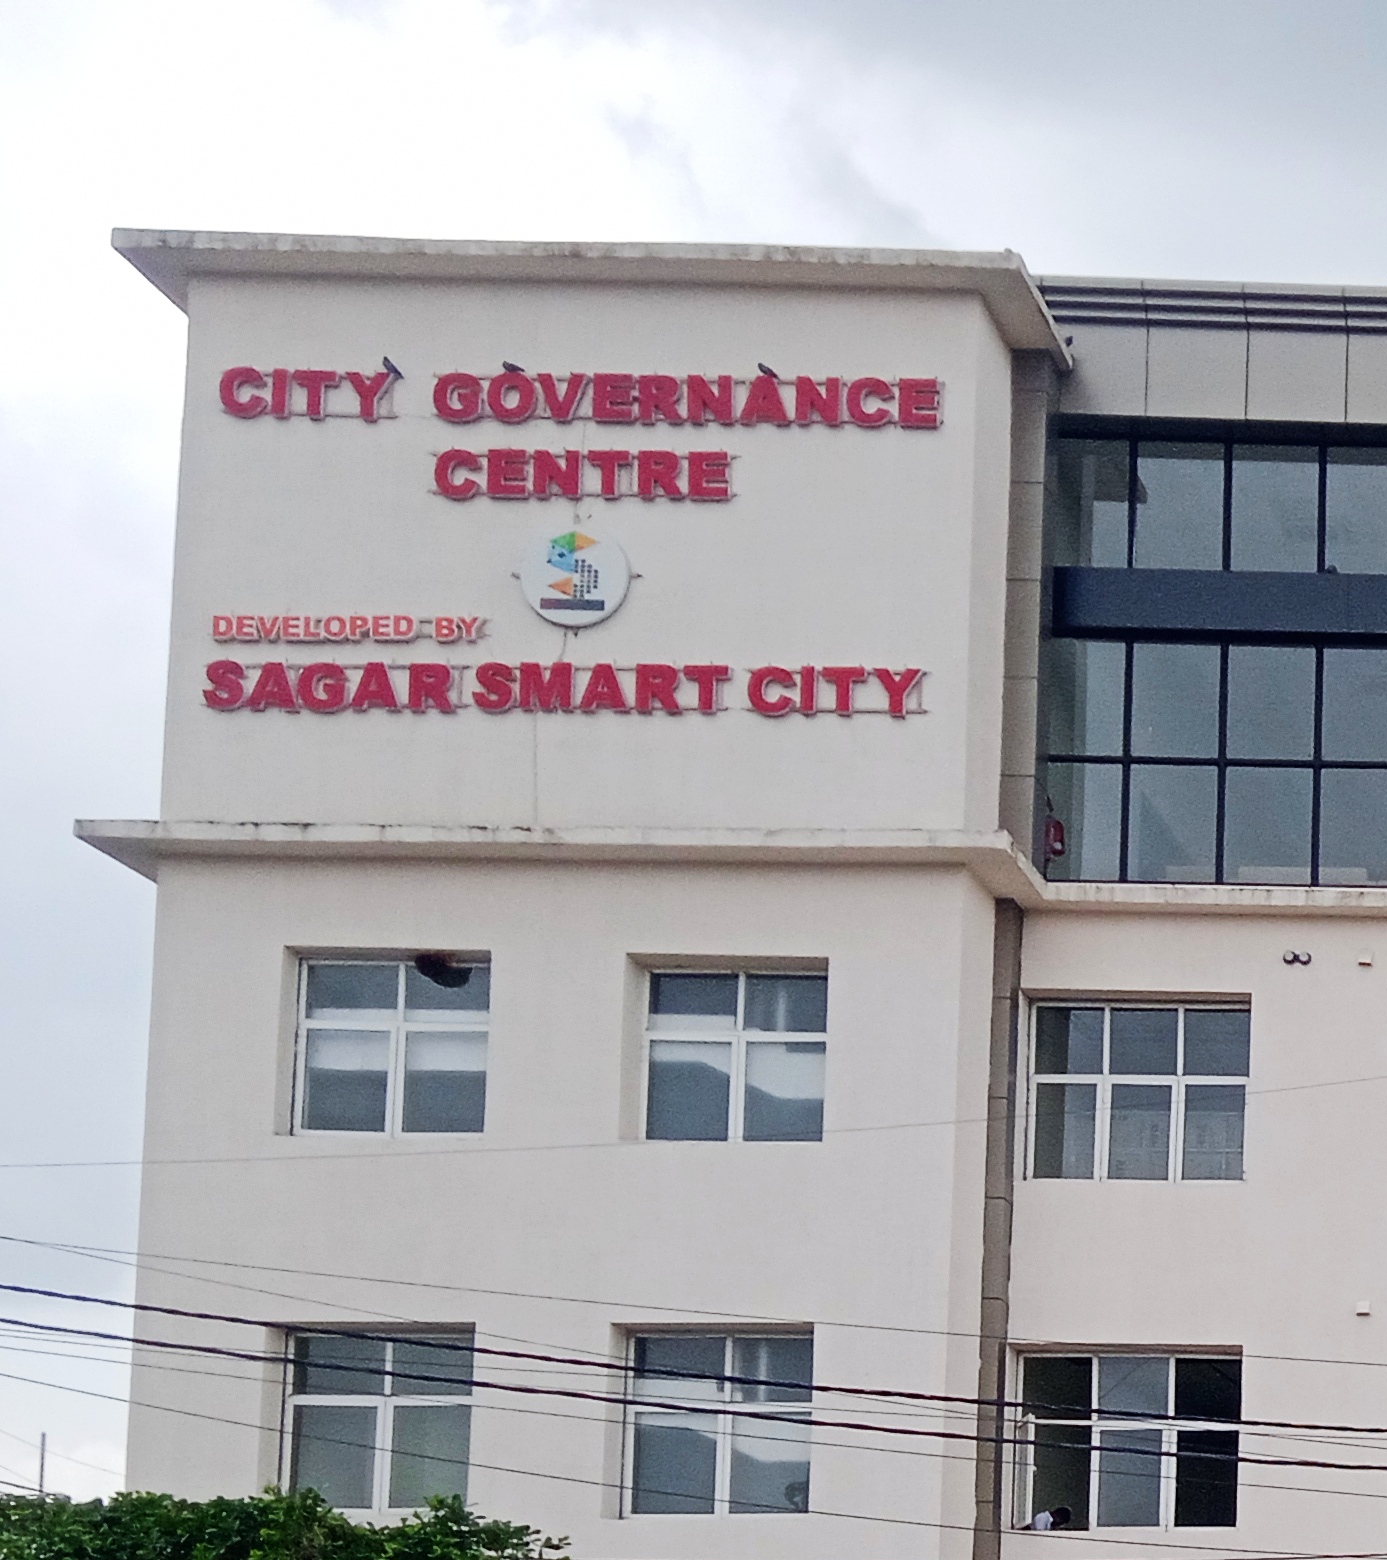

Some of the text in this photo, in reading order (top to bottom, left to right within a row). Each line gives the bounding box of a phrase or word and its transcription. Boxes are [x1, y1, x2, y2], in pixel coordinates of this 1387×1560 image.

[219, 366, 940, 428] CITY GOVERNANCE
[433, 448, 731, 499] CENTRE
[212, 615, 480, 641] DEVELOPED BY
[203, 659, 922, 716] SAGAR SMART CITY
